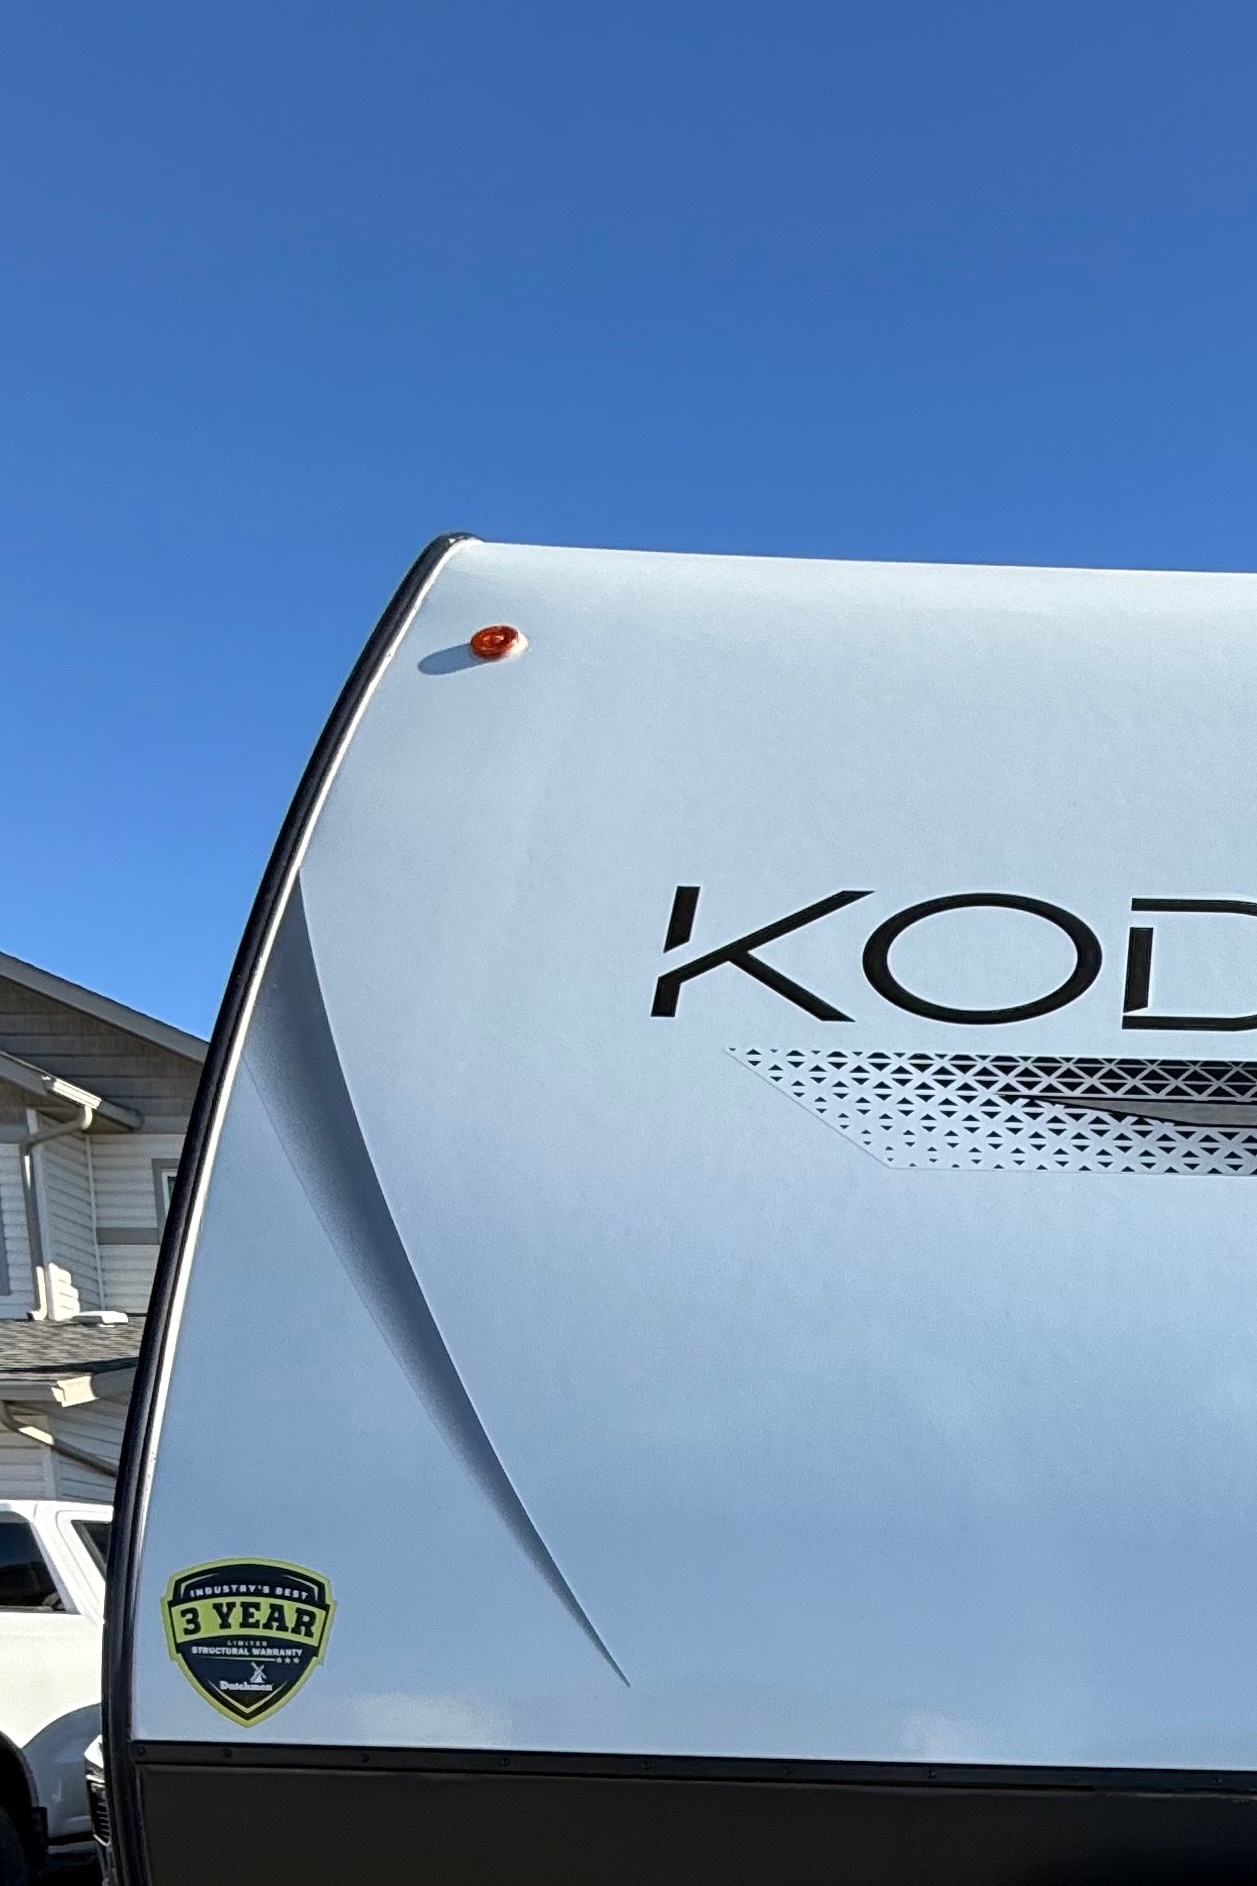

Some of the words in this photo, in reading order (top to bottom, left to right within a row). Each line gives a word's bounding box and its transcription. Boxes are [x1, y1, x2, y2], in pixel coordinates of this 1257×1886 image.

[190, 1584, 270, 1598] INDUSTRY'S
[275, 1587, 309, 1600] BEST
[180, 1607, 202, 1636] 3
[212, 1601, 317, 1638] YEAR
[227, 1639, 268, 1647] LIMITED
[191, 1646, 250, 1657] STRUCTURAL
[251, 1647, 303, 1657] WARRANTY
[219, 1680, 273, 1692] Dutchmen
